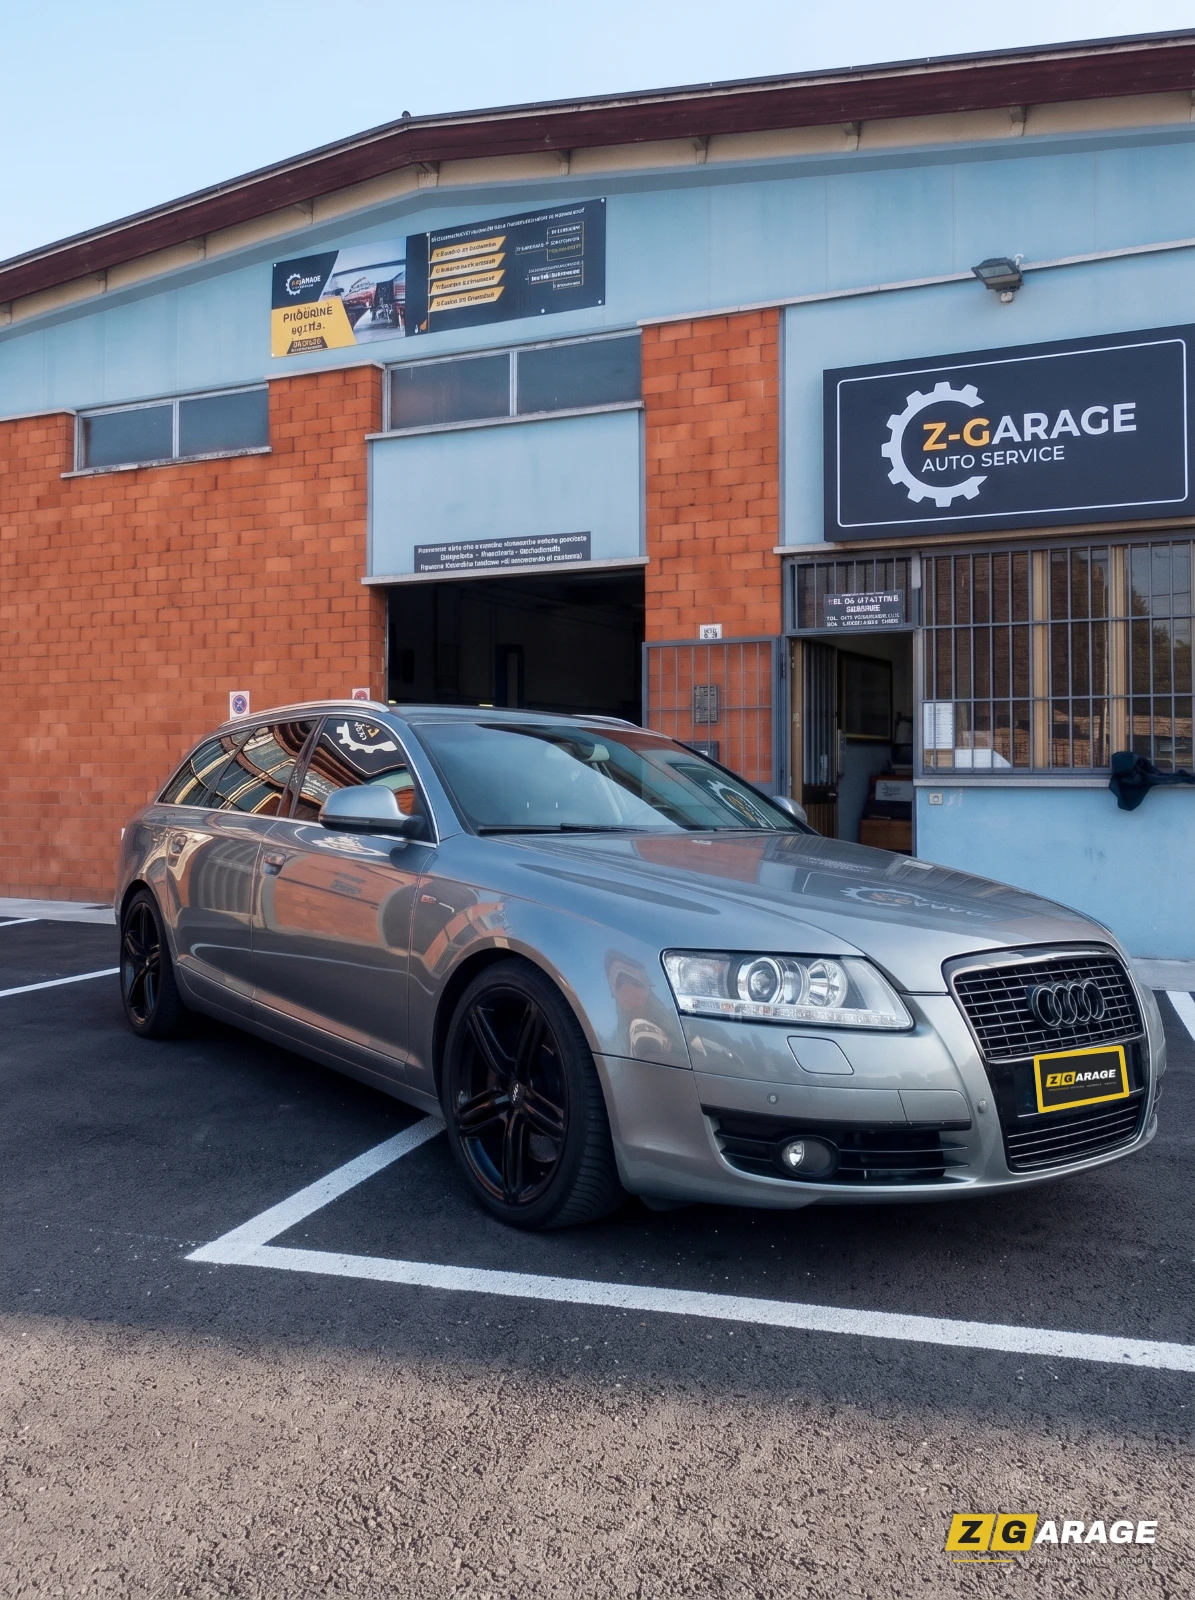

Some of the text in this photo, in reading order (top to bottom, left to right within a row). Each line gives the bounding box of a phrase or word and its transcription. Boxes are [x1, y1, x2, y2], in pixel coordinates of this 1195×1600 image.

[922, 402, 1137, 452] Z-GARAGE
[921, 445, 1065, 473] AUTO SERVICE
